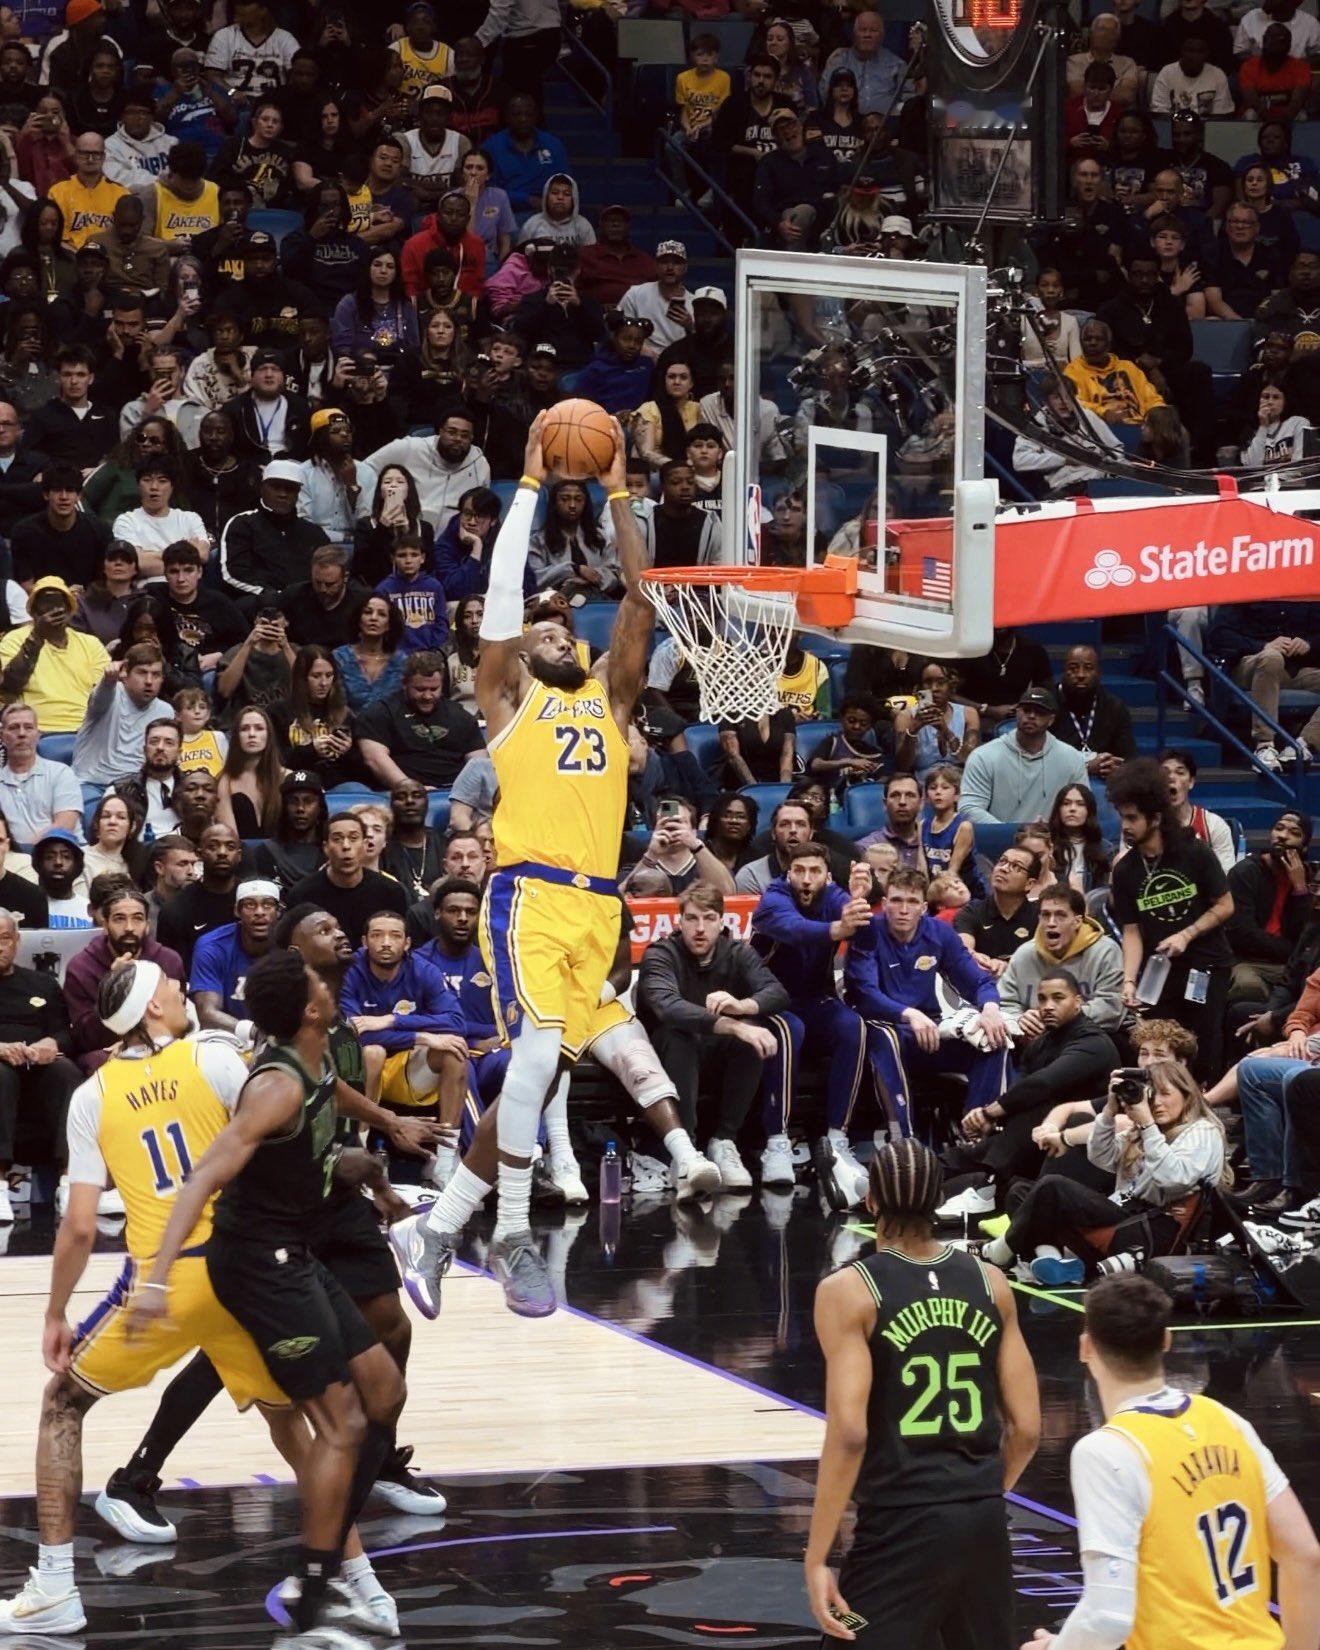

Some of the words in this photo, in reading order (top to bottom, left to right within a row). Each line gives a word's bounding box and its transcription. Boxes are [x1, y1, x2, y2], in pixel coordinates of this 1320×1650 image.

[554, 724, 608, 774] 23
[1142, 887, 1193, 908] PELICANS
[125, 1079, 179, 1112] HAYES
[141, 1120, 194, 1193] 11
[880, 1297, 970, 1353] MURPHY
[966, 1309, 998, 1348] III
[899, 1352, 983, 1436] 25
[1197, 1501, 1256, 1606] 12
